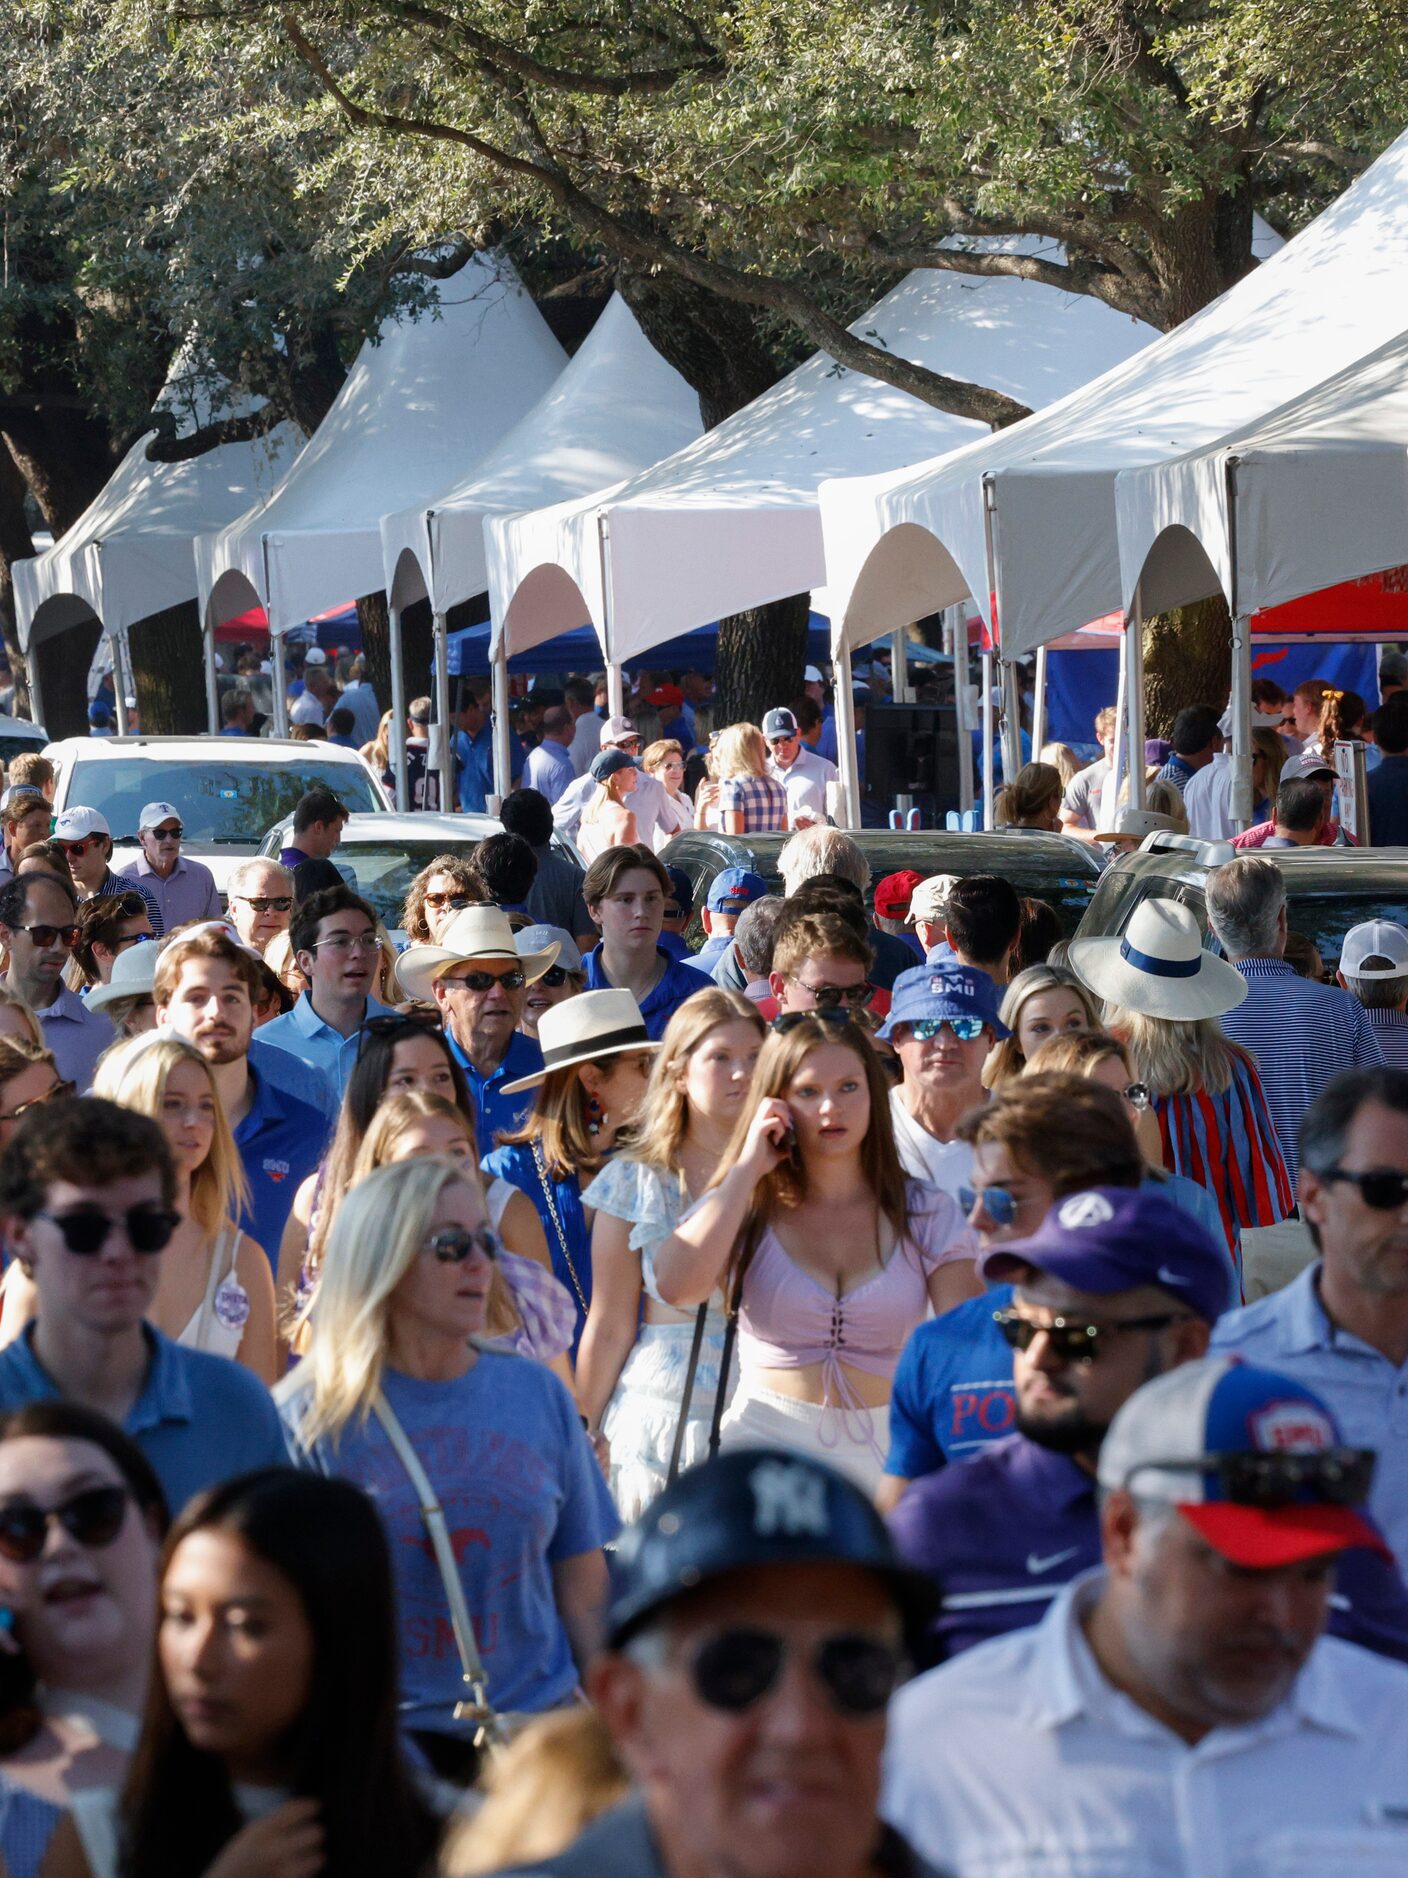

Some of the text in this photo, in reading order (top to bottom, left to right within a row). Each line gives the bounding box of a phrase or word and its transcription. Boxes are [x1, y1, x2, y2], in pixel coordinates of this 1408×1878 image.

[931, 982, 975, 997] SMU
[950, 1391, 1016, 1435] PO
[749, 1460, 829, 1536] NY
